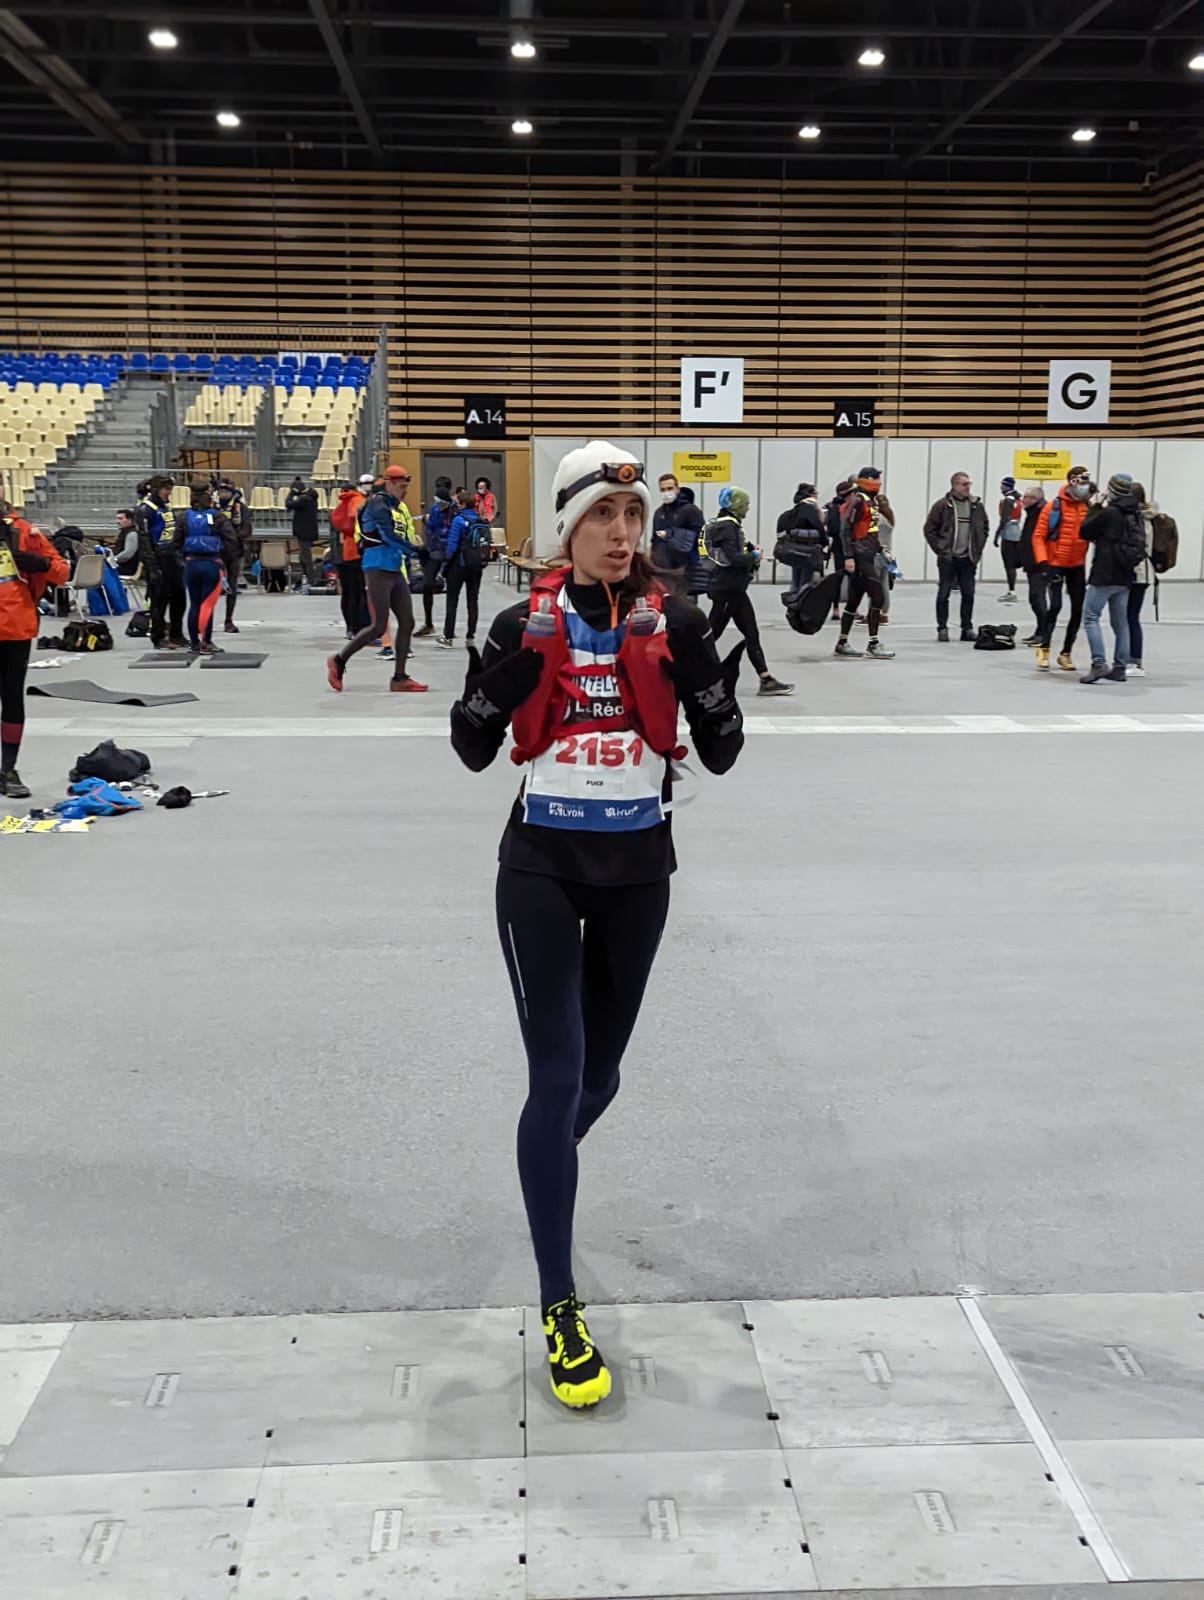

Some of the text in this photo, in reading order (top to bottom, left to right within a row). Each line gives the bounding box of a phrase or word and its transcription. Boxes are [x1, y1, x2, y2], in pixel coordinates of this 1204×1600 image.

[1060, 371, 1098, 410] G
[555, 736, 644, 767] 2151
[563, 808, 585, 818] LYON
